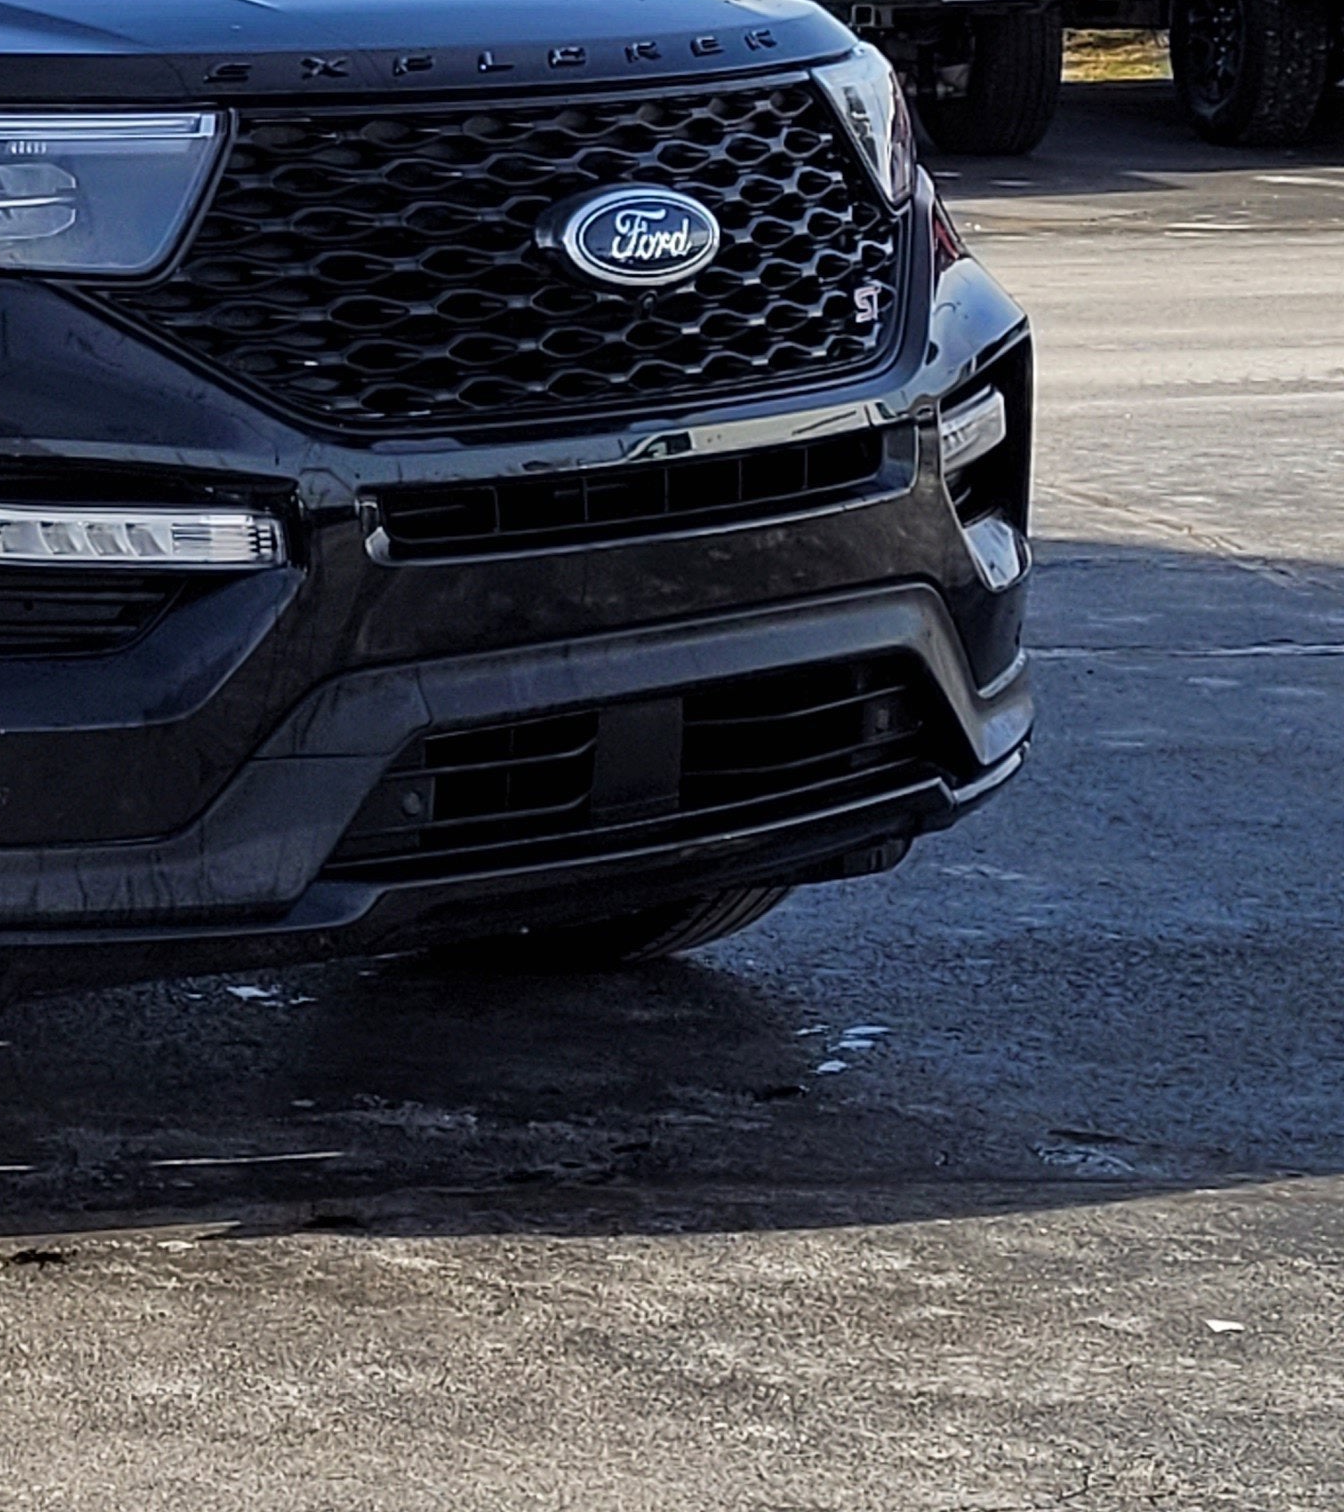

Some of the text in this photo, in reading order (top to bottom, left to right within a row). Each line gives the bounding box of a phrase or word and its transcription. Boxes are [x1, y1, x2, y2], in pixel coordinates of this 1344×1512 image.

[202, 27, 780, 84] EXPLORER
[611, 207, 693, 260] Ford
[853, 285, 882, 324] ST
